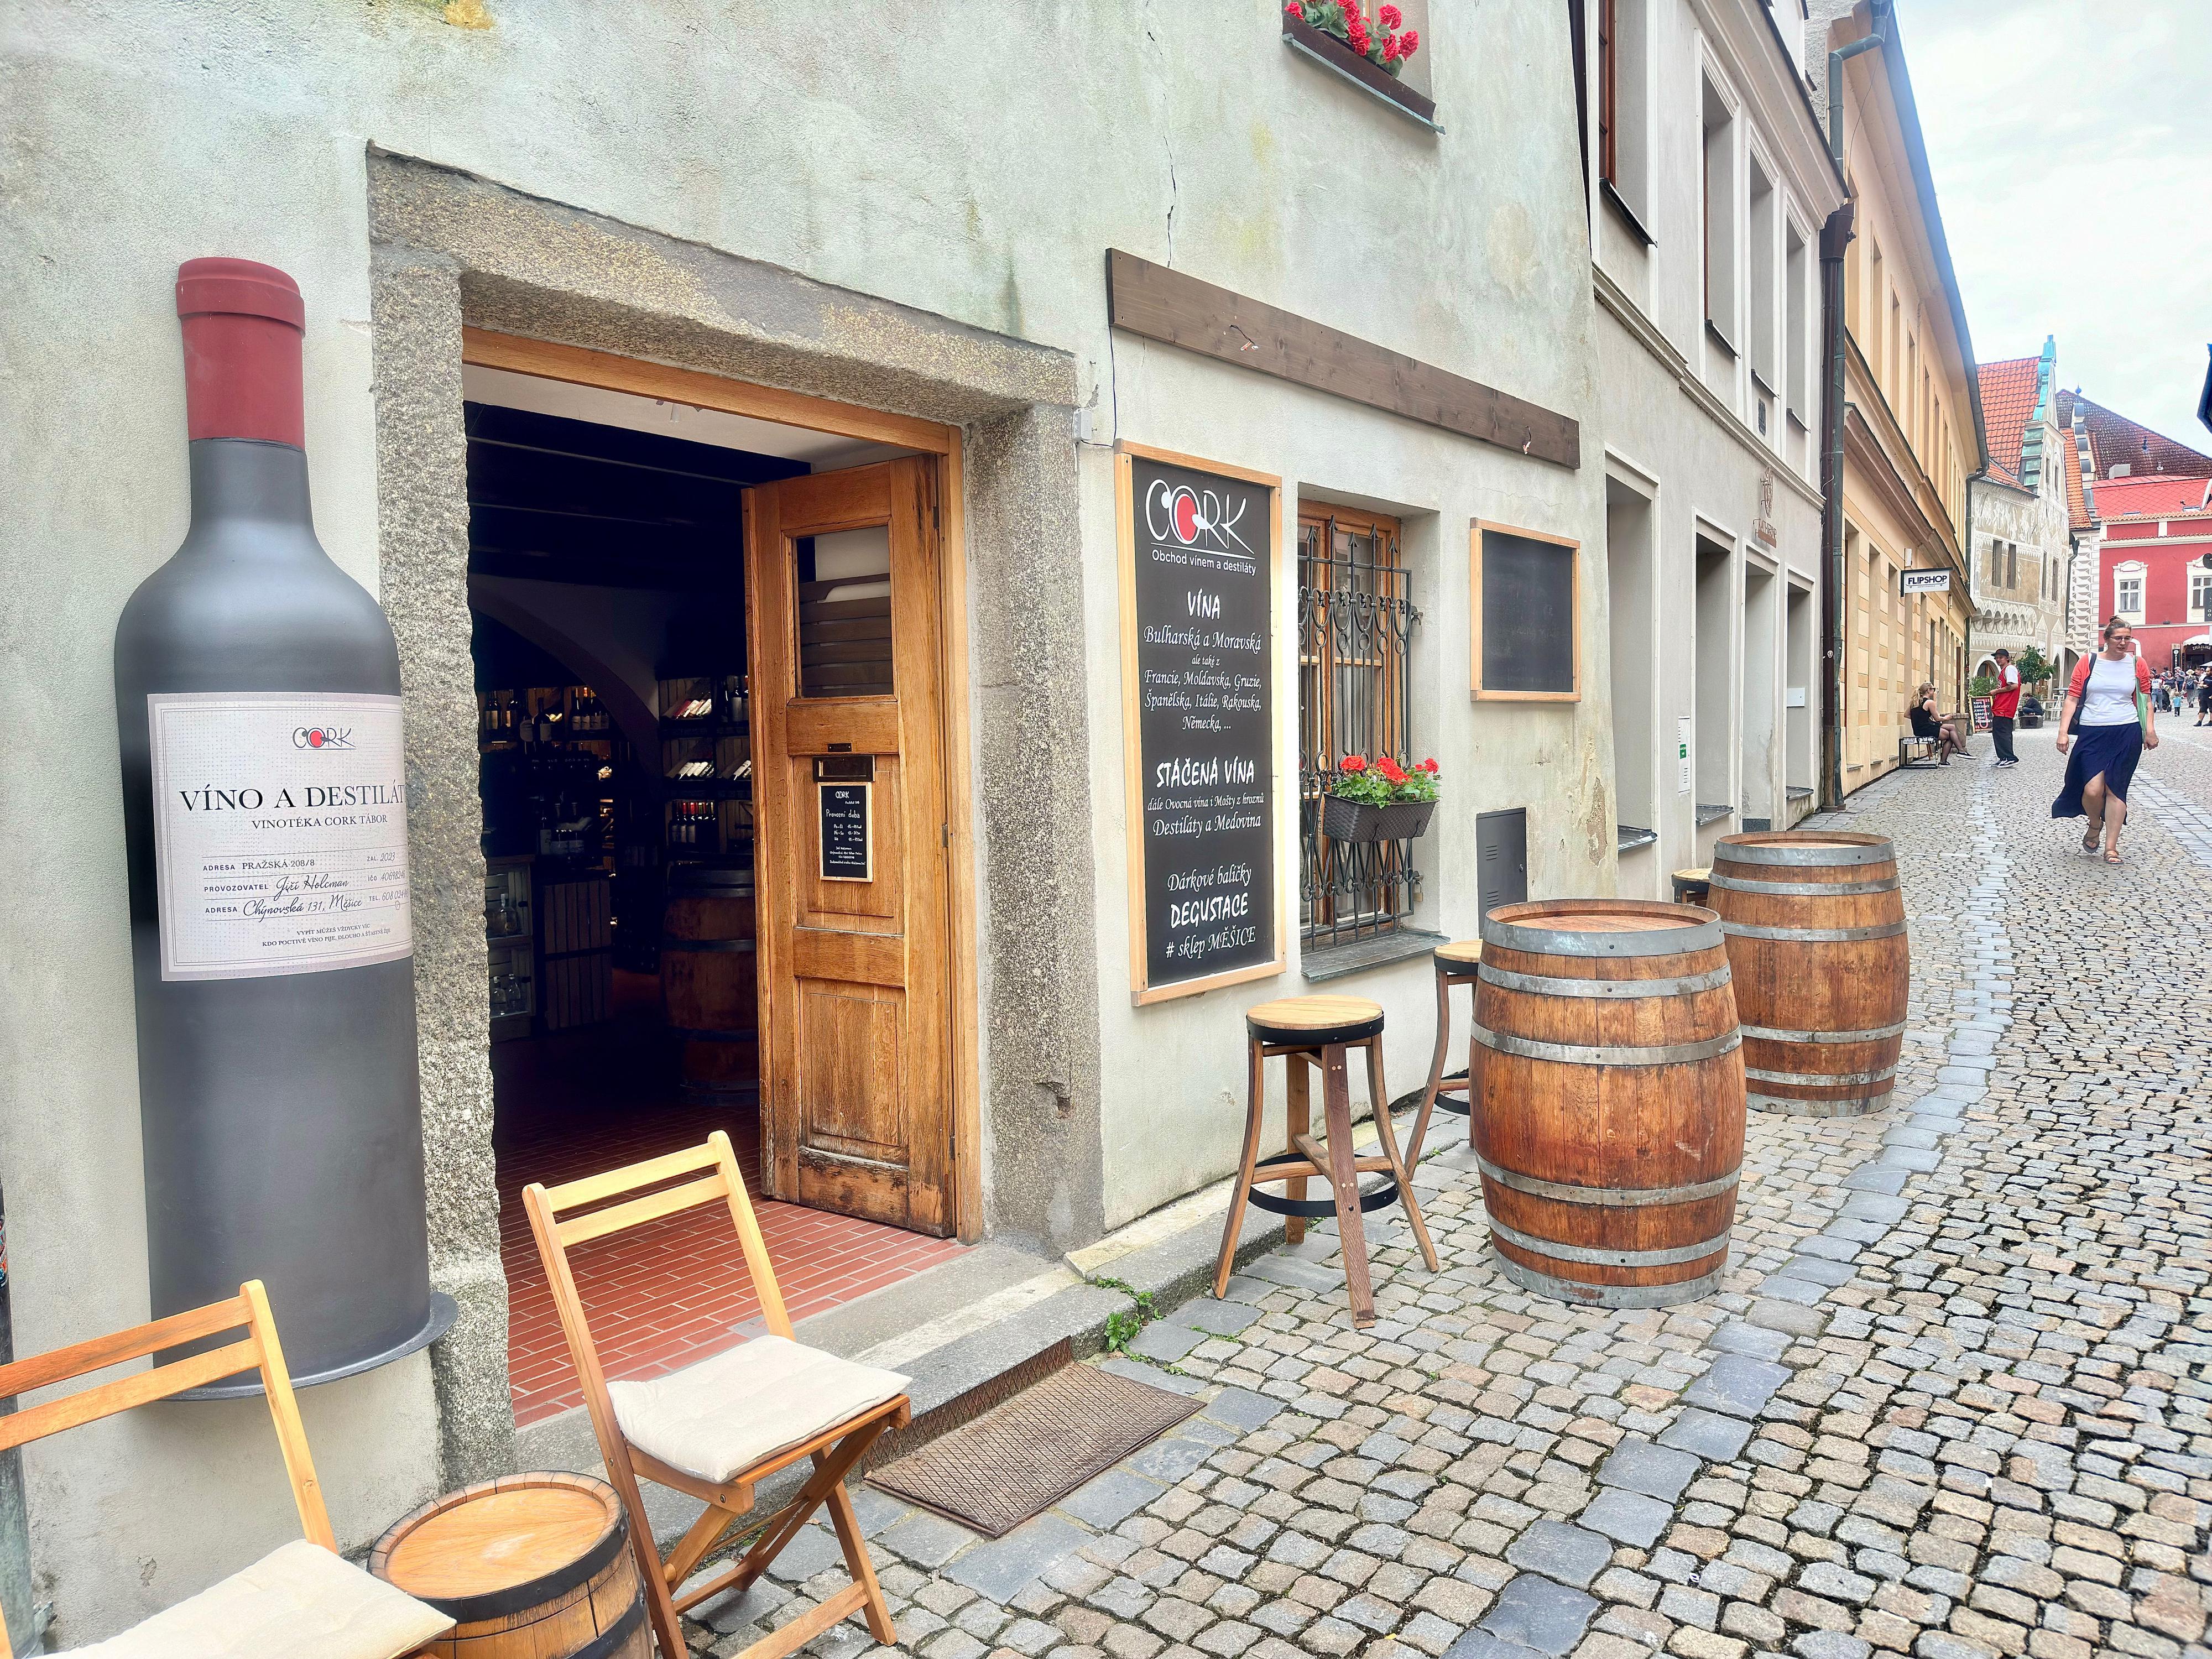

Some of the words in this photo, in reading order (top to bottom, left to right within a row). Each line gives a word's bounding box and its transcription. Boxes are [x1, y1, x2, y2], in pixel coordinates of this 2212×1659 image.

[1146, 479, 1255, 554] CORK
[1152, 549, 1187, 565] Obchod
[1190, 555, 1214, 568] vínem
[1216, 561, 1221, 569] a
[1223, 560, 1256, 576] destiláty
[1187, 588, 1220, 620] VÍNA
[1144, 624, 1201, 650] Bulharská
[1203, 635, 1210, 647] a
[1212, 632, 1261, 655] Moravská
[1192, 654, 1201, 665] ale
[1202, 654, 1215, 668] také
[1144, 670, 1181, 687] Francie,
[1183, 670, 1231, 690] Moldavska,
[1234, 674, 1261, 691] Gruzie,
[1144, 688, 1192, 711] Španělska,
[1194, 692, 1219, 710] Itálie,
[1222, 693, 1261, 712] Rakouska,
[1182, 714, 1222, 733] Německa,
[293, 727, 357, 748] CORK
[1156, 756, 1218, 788] STÁČENÁ
[1224, 755, 1254, 784] VÍNA
[179, 784, 263, 811] VÍNO
[274, 788, 296, 808] A
[1147, 797, 1163, 811] dále
[1165, 796, 1192, 810] Ovocná
[1193, 795, 1209, 808] vína
[1210, 795, 1213, 807] i
[1214, 794, 1235, 810] Mošty
[1242, 792, 1264, 805] hroznů
[252, 817, 321, 830] VINOTÉKA
[325, 816, 357, 826] CORK
[359, 813, 388, 824] TÁBOR
[848, 809, 860, 818] doba
[1153, 815, 1203, 839] Destiláty
[1205, 820, 1212, 832] a
[1214, 811, 1261, 831] Medovina
[242, 859, 289, 870] PRAŽSKÁ
[290, 859, 315, 868] 208/8
[380, 852, 395, 862] 2023
[273, 876, 299, 901] Jiří
[303, 874, 349, 890] Holcman
[1167, 868, 1215, 893] Dárkové
[1217, 862, 1252, 887] balíčky
[243, 897, 304, 922] Chýnovská
[307, 901, 325, 912] 131,
[329, 894, 362, 911] Měšice
[1171, 892, 1248, 929] DEGUSTACE
[1166, 941, 1175, 958] #
[1178, 934, 1206, 959] sklep
[1208, 924, 1256, 952] MĚŠICE
